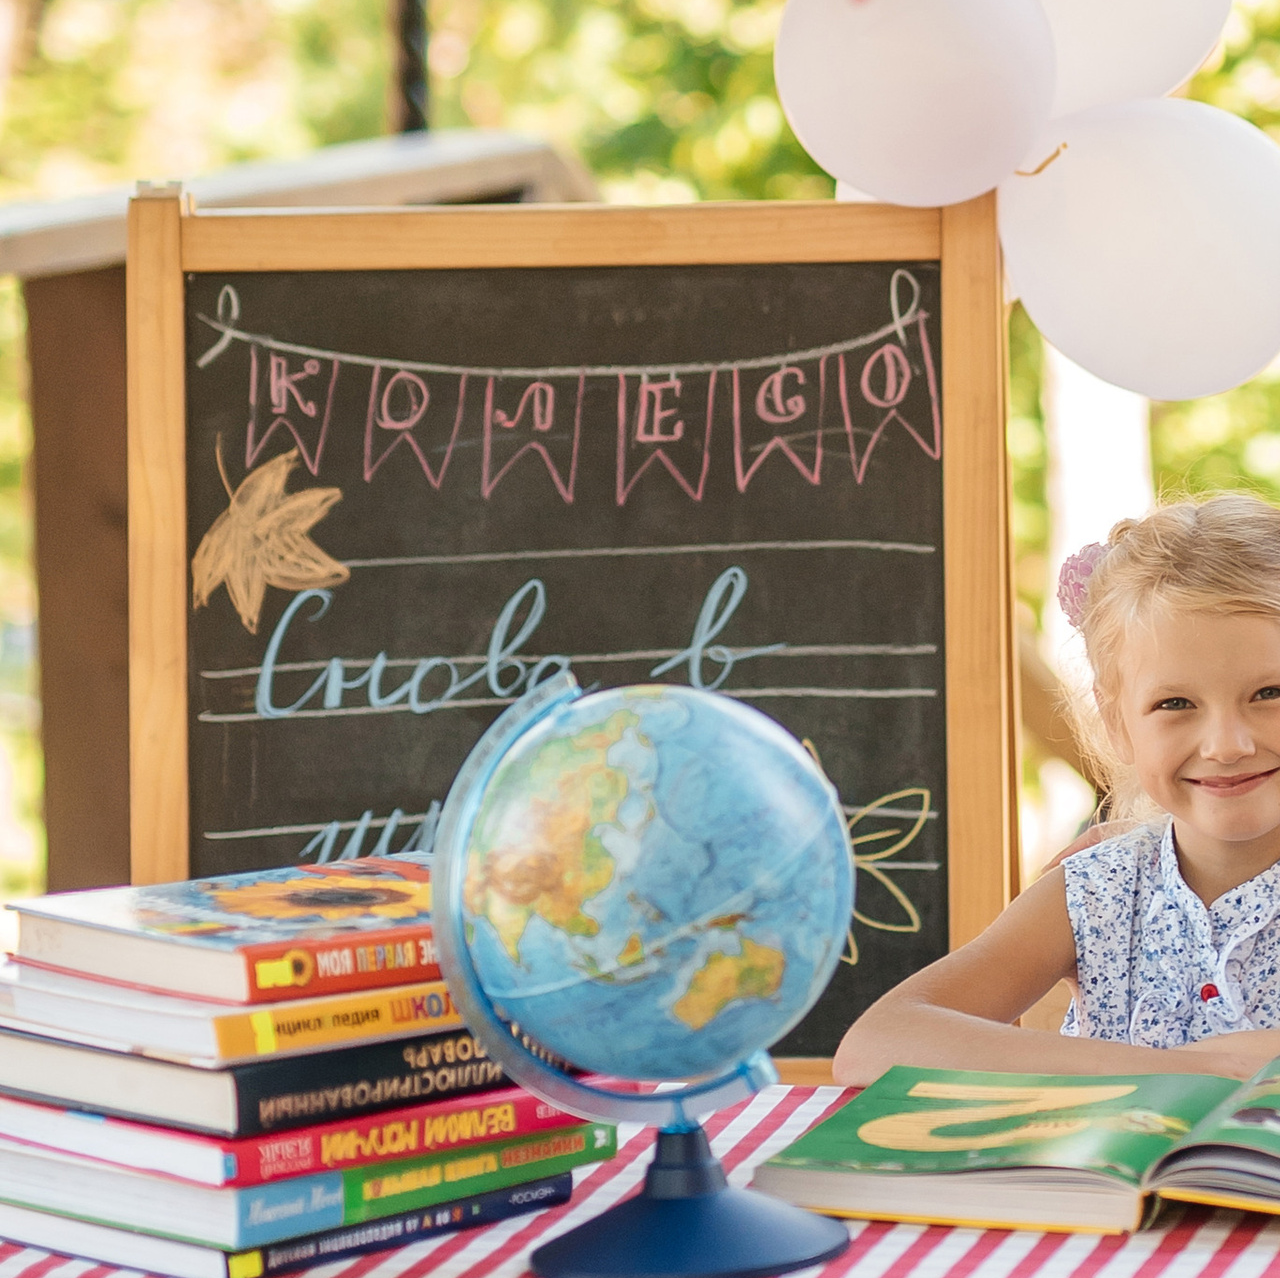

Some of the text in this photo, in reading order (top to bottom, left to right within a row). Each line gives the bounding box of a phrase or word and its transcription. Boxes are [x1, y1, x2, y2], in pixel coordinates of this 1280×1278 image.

[316, 948, 354, 978] МОЯ
[355, 939, 416, 972] ПЕРВАЯ
[389, 992, 459, 1023] ШКОЛ
[402, 1035, 488, 1069] ЛОВАРЬ
[258, 1061, 503, 1126] ИЛЛЮСТРИРОВАННЫЙ
[257, 1136, 313, 1164] ЯЗЫК
